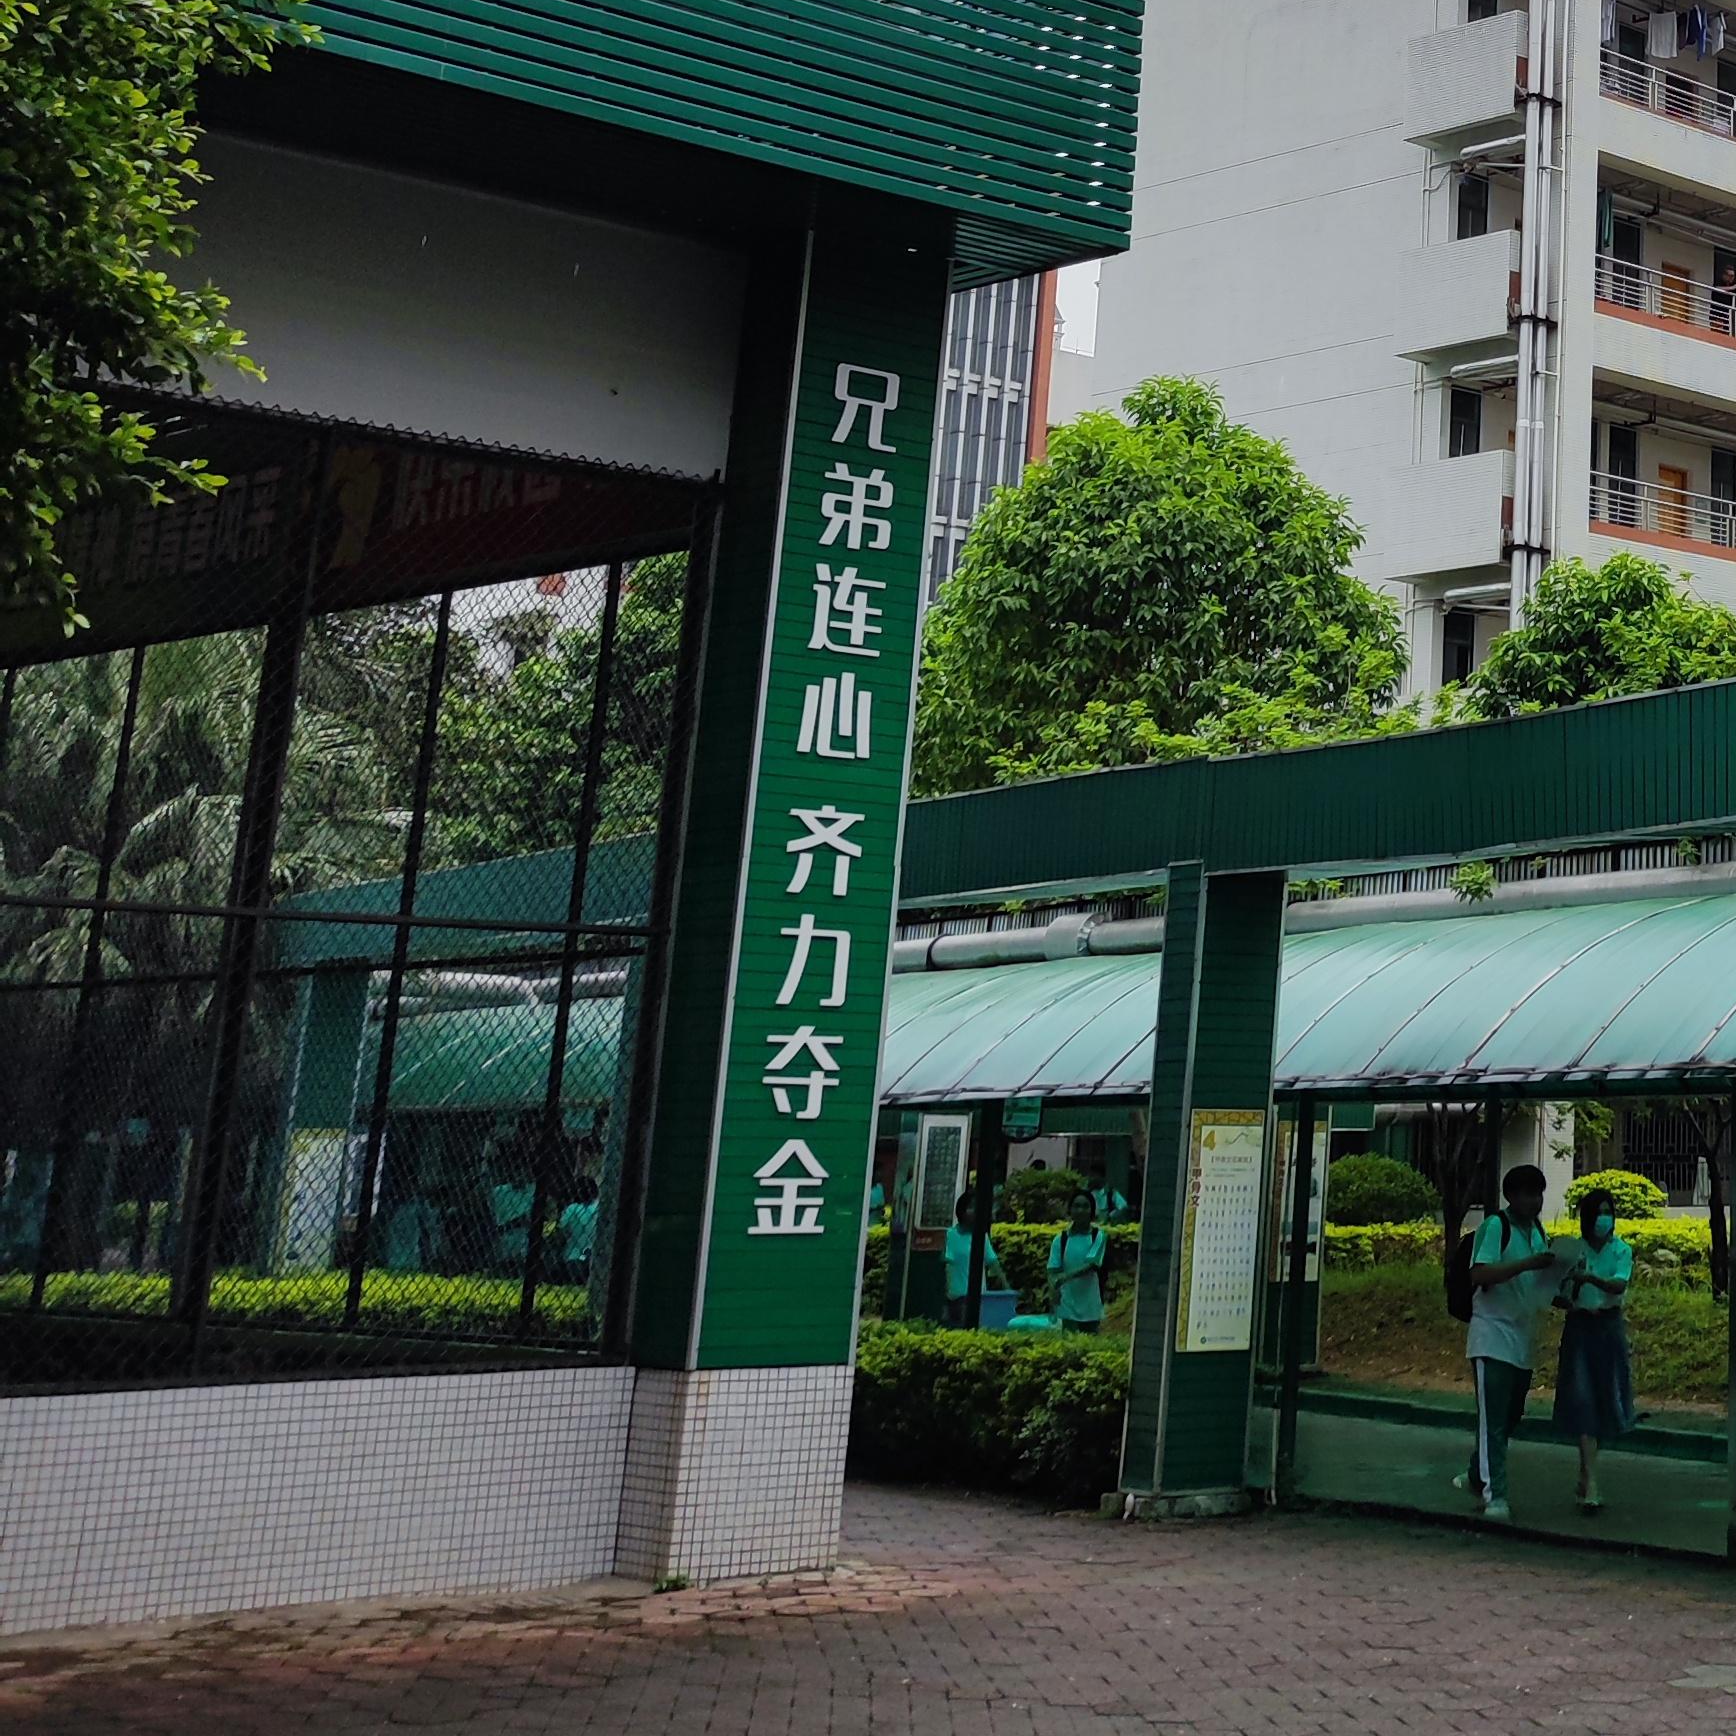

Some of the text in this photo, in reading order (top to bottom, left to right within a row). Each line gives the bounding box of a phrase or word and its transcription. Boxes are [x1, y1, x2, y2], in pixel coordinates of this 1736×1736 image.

[747, 363, 900, 1235] 兄弟连心 齐力夺金
[1191, 1168, 1202, 1207] 甲骨文
